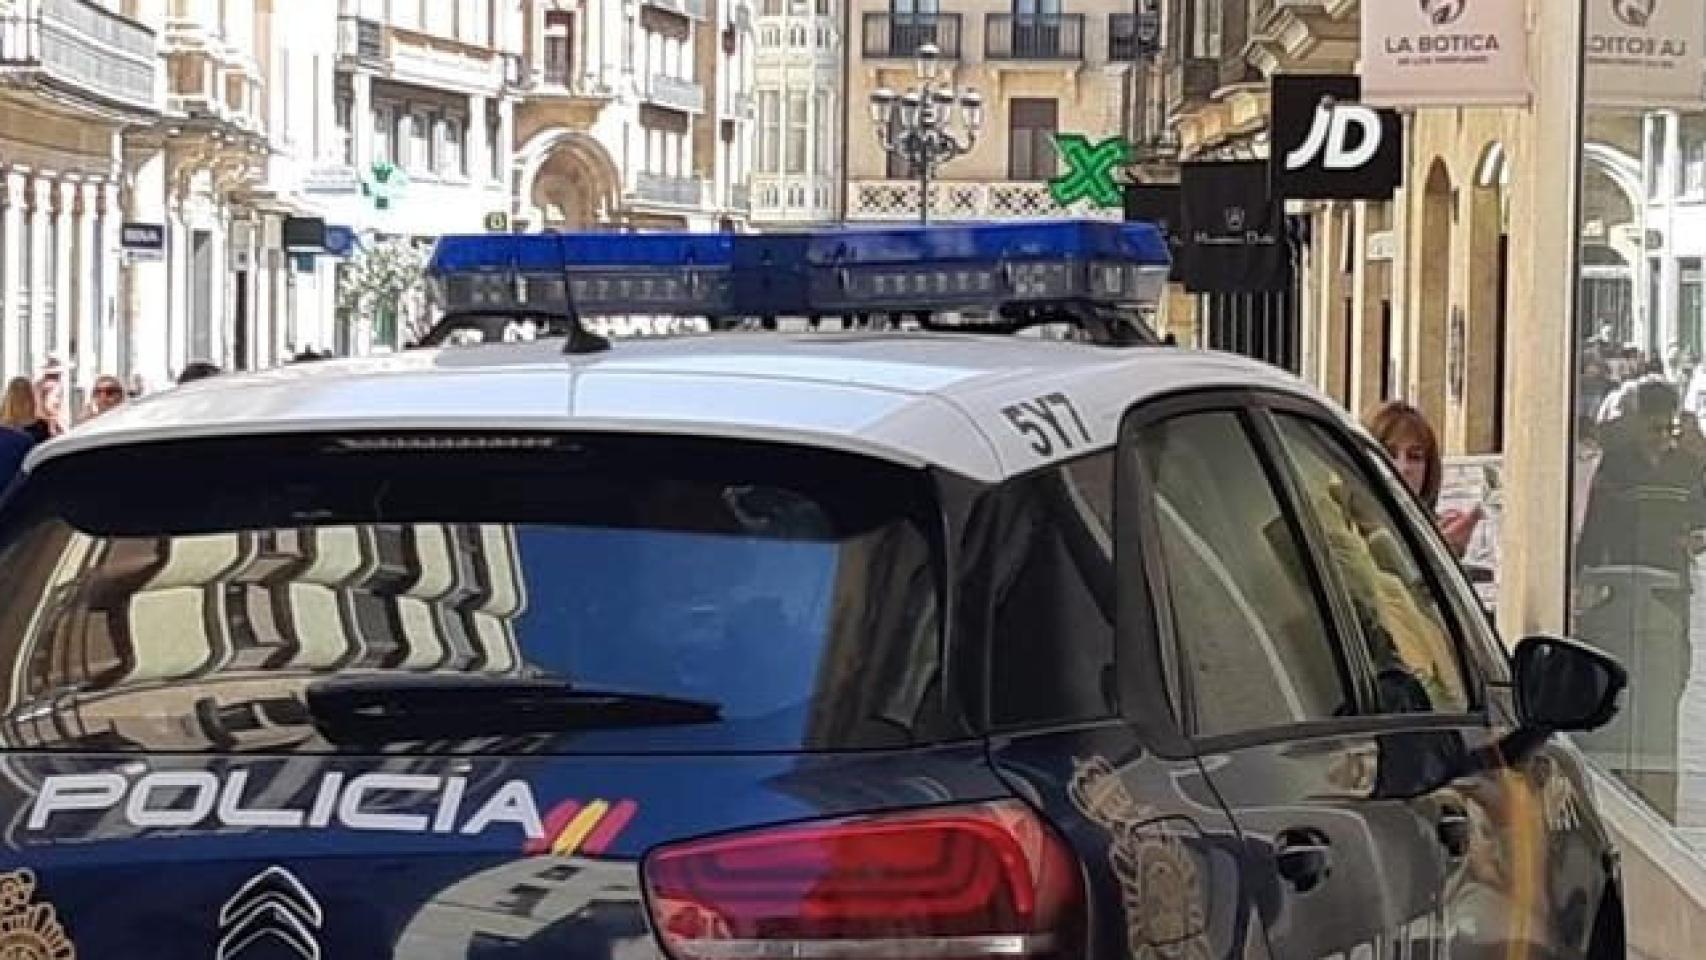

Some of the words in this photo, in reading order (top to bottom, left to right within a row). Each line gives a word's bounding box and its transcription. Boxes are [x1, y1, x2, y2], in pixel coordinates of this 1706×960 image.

[1384, 36, 1412, 54] LA
[1418, 34, 1500, 54] BOTICA
[1286, 94, 1383, 169] JD
[1000, 392, 1092, 457] 5Y7
[27, 765, 546, 840] POLICÍA
